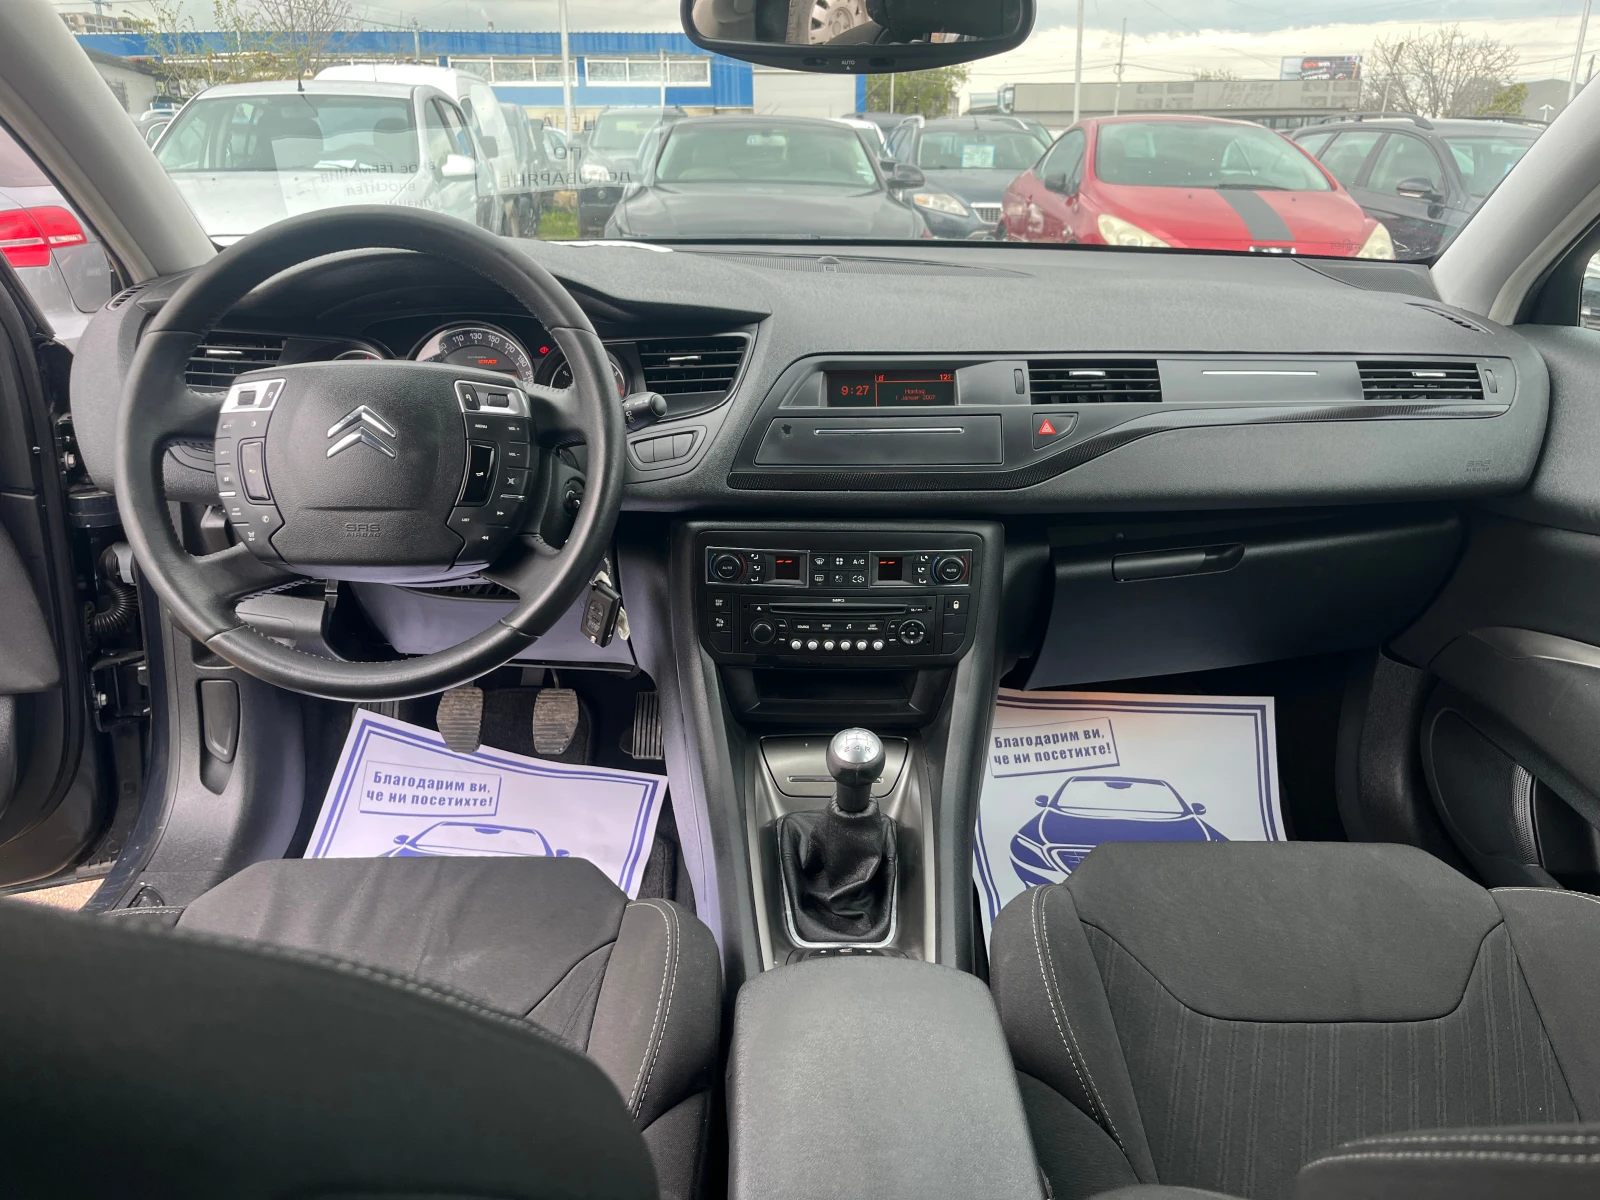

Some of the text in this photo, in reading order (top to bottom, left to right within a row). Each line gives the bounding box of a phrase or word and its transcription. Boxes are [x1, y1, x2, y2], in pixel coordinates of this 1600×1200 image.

[452, 334, 464, 343] 110
[488, 334, 500, 343] 150
[504, 342, 515, 353] 170
[517, 354, 528, 367] 190
[841, 385, 869, 395] 9:27
[345, 523, 381, 532] SRS
[994, 728, 1105, 748] Благодарим ви,
[994, 742, 1112, 765] че ни посетихте!
[373, 771, 490, 793] Благодарим ви,
[366, 790, 493, 806] че ни посетихте!
